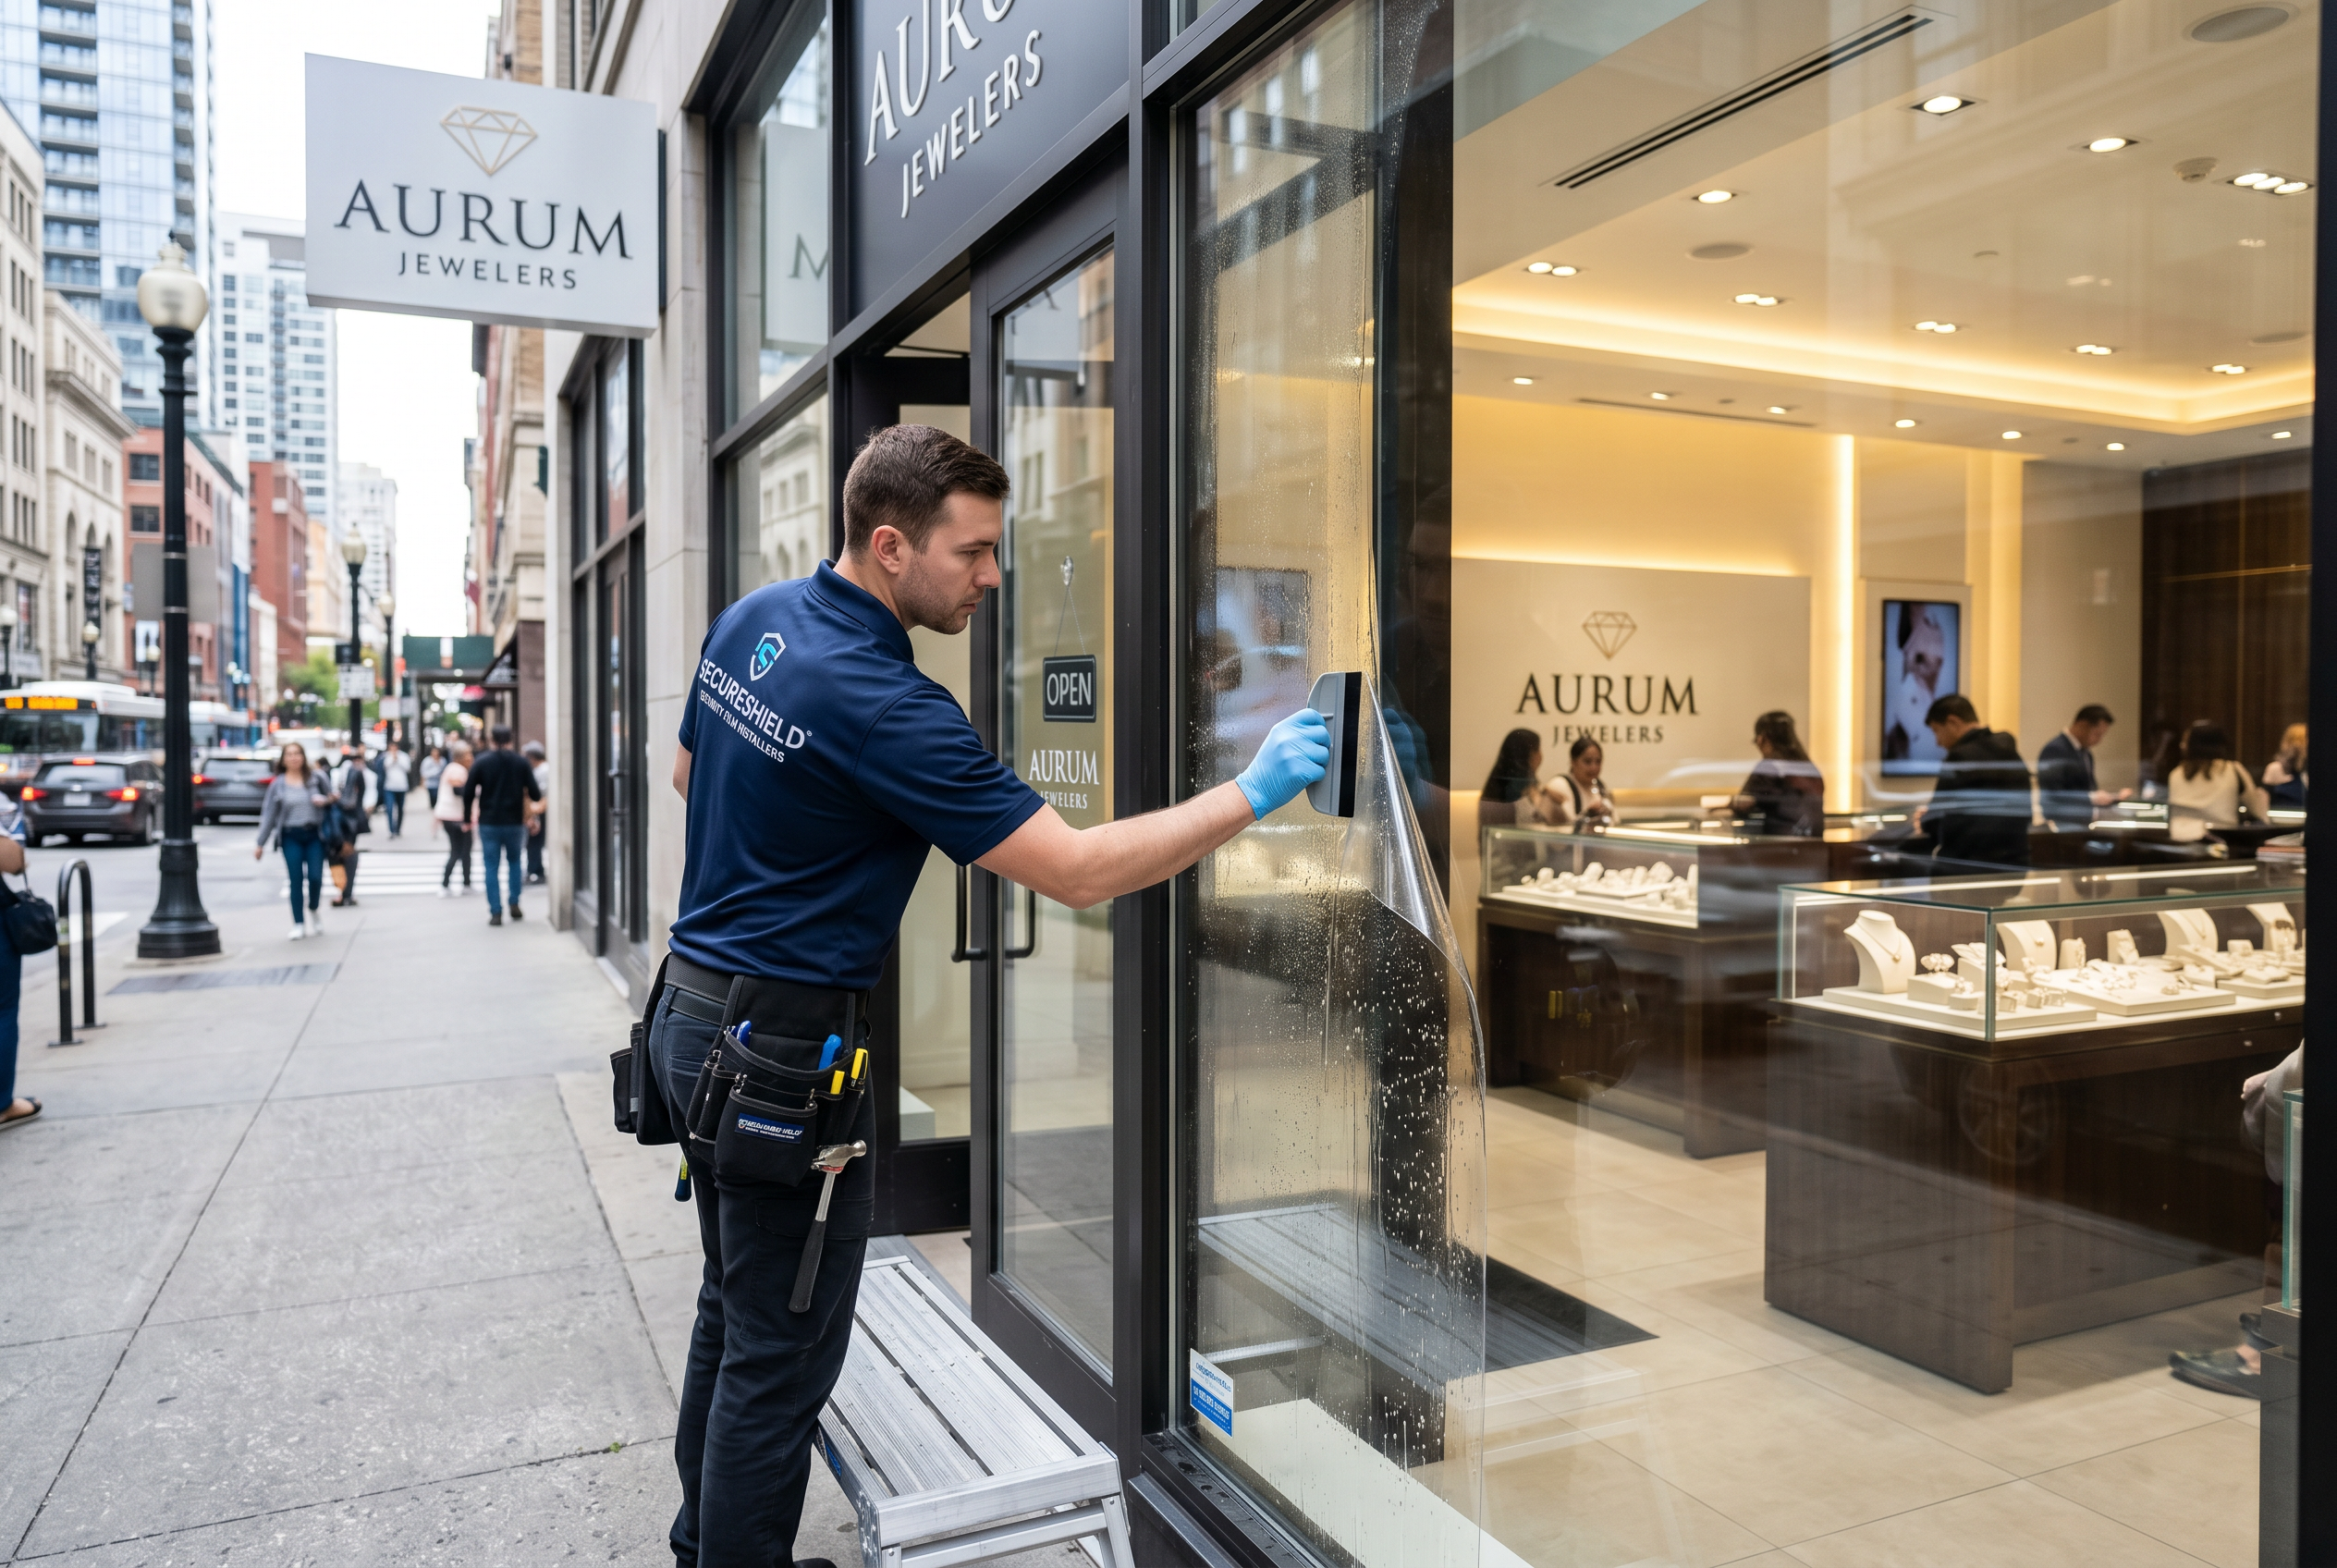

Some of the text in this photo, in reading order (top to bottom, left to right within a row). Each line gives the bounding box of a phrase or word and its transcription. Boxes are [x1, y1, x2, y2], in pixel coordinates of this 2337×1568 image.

[901, 30, 1041, 218] JEWELERS
[334, 178, 633, 260] AURUM
[398, 251, 576, 289] JEWELERS
[699, 658, 805, 749] SECURESHIELD
[1046, 672, 1092, 705] OPEN
[1514, 672, 1699, 716] AURUM
[1028, 749, 1099, 785] AURUM
